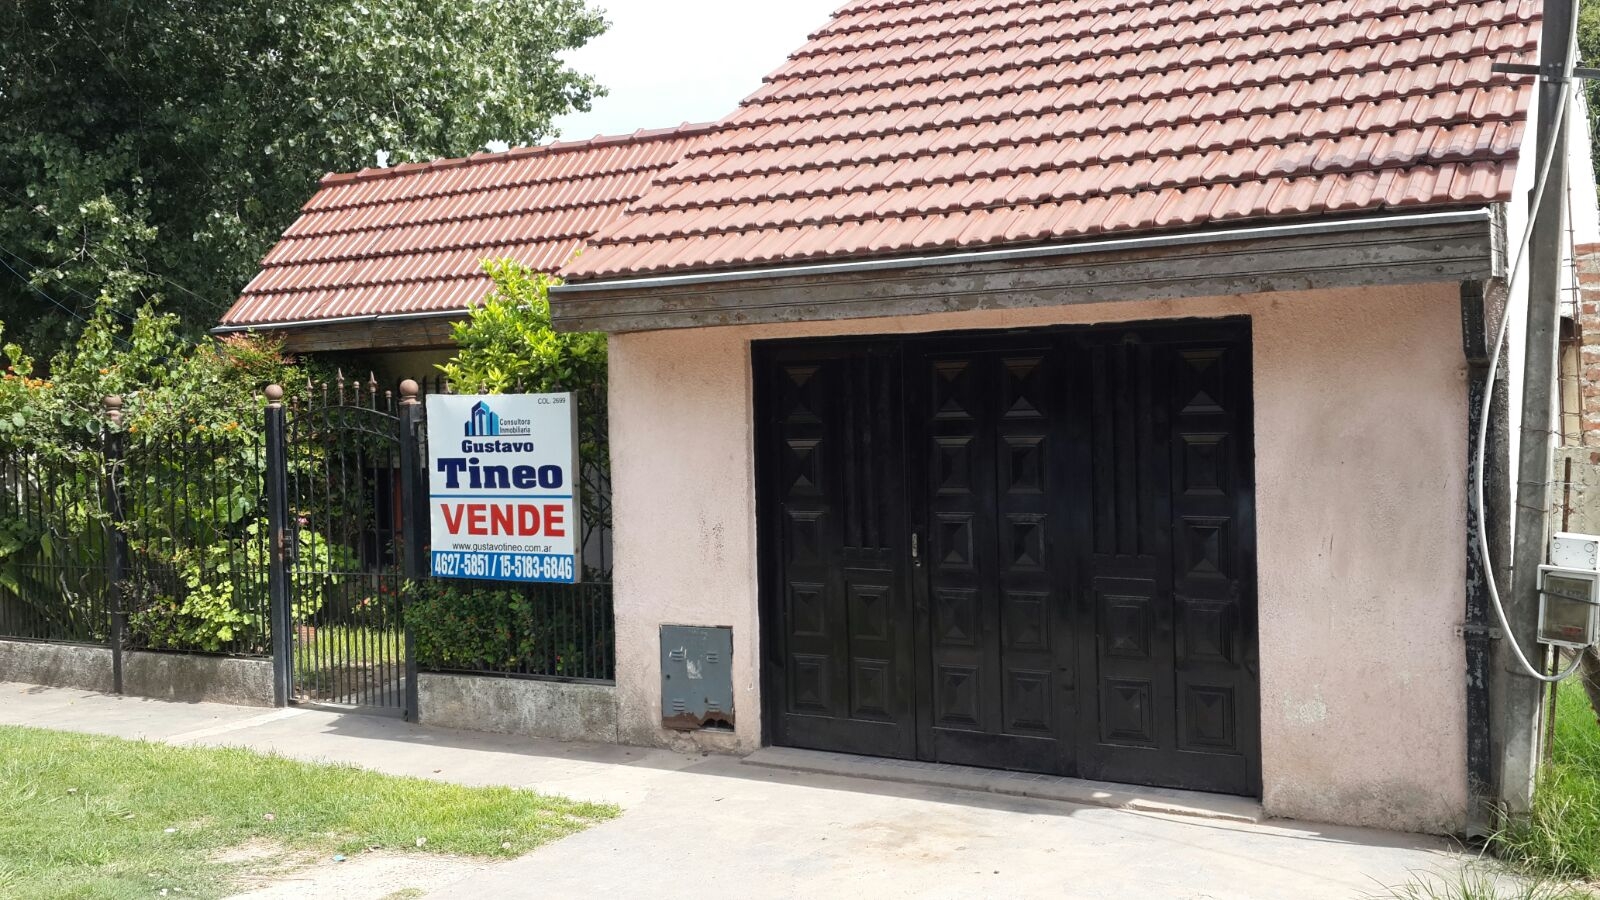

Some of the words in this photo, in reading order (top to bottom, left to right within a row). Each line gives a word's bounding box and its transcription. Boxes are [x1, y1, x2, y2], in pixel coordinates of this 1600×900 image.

[462, 440, 534, 453] Gustavo
[437, 457, 563, 490] Tineo
[440, 504, 565, 537] VENDE
[452, 542, 552, 552] www.gustavotineo.com.ar
[434, 554, 488, 576] 4627-5851
[491, 556, 497, 576] /
[500, 556, 572, 580] 15-5183-6846
